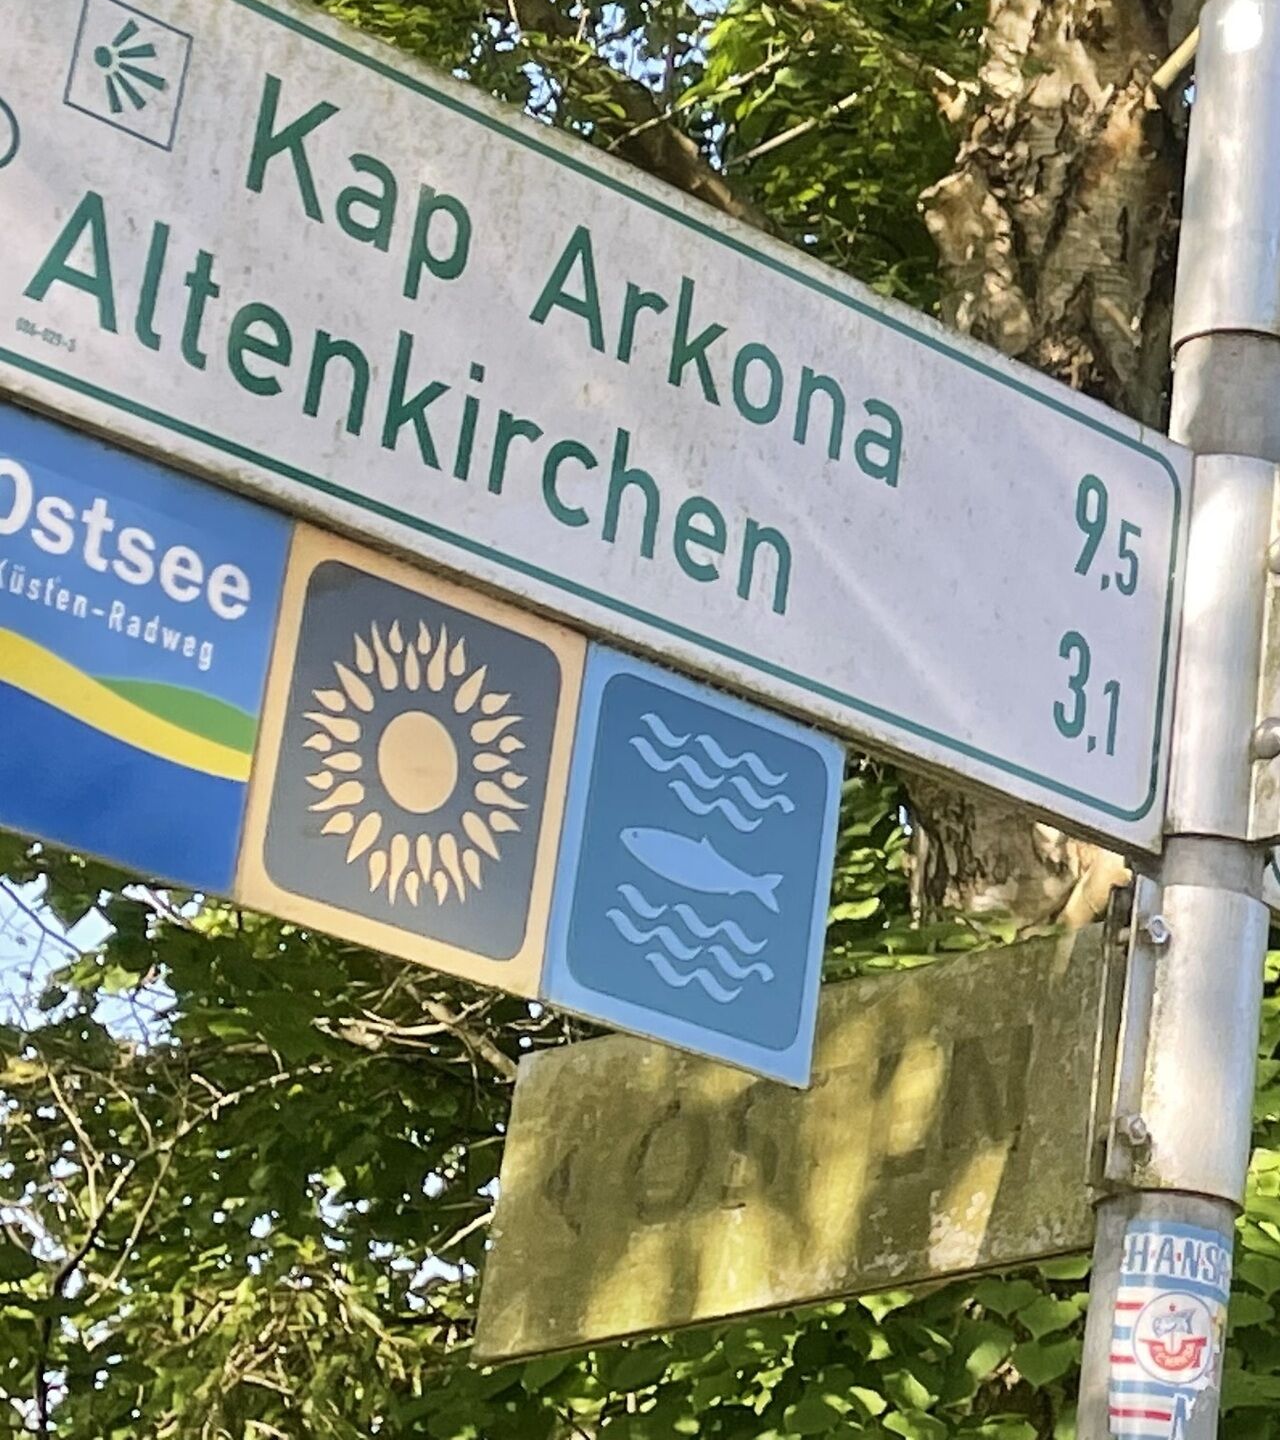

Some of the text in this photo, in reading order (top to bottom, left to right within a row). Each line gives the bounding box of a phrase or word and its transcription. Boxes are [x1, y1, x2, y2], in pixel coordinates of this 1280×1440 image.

[0, 457, 251, 621] Ostsee
[24, 190, 1121, 758] Altenkirchen 3,1
[245, 73, 1142, 597] Kap Arkona 9,5
